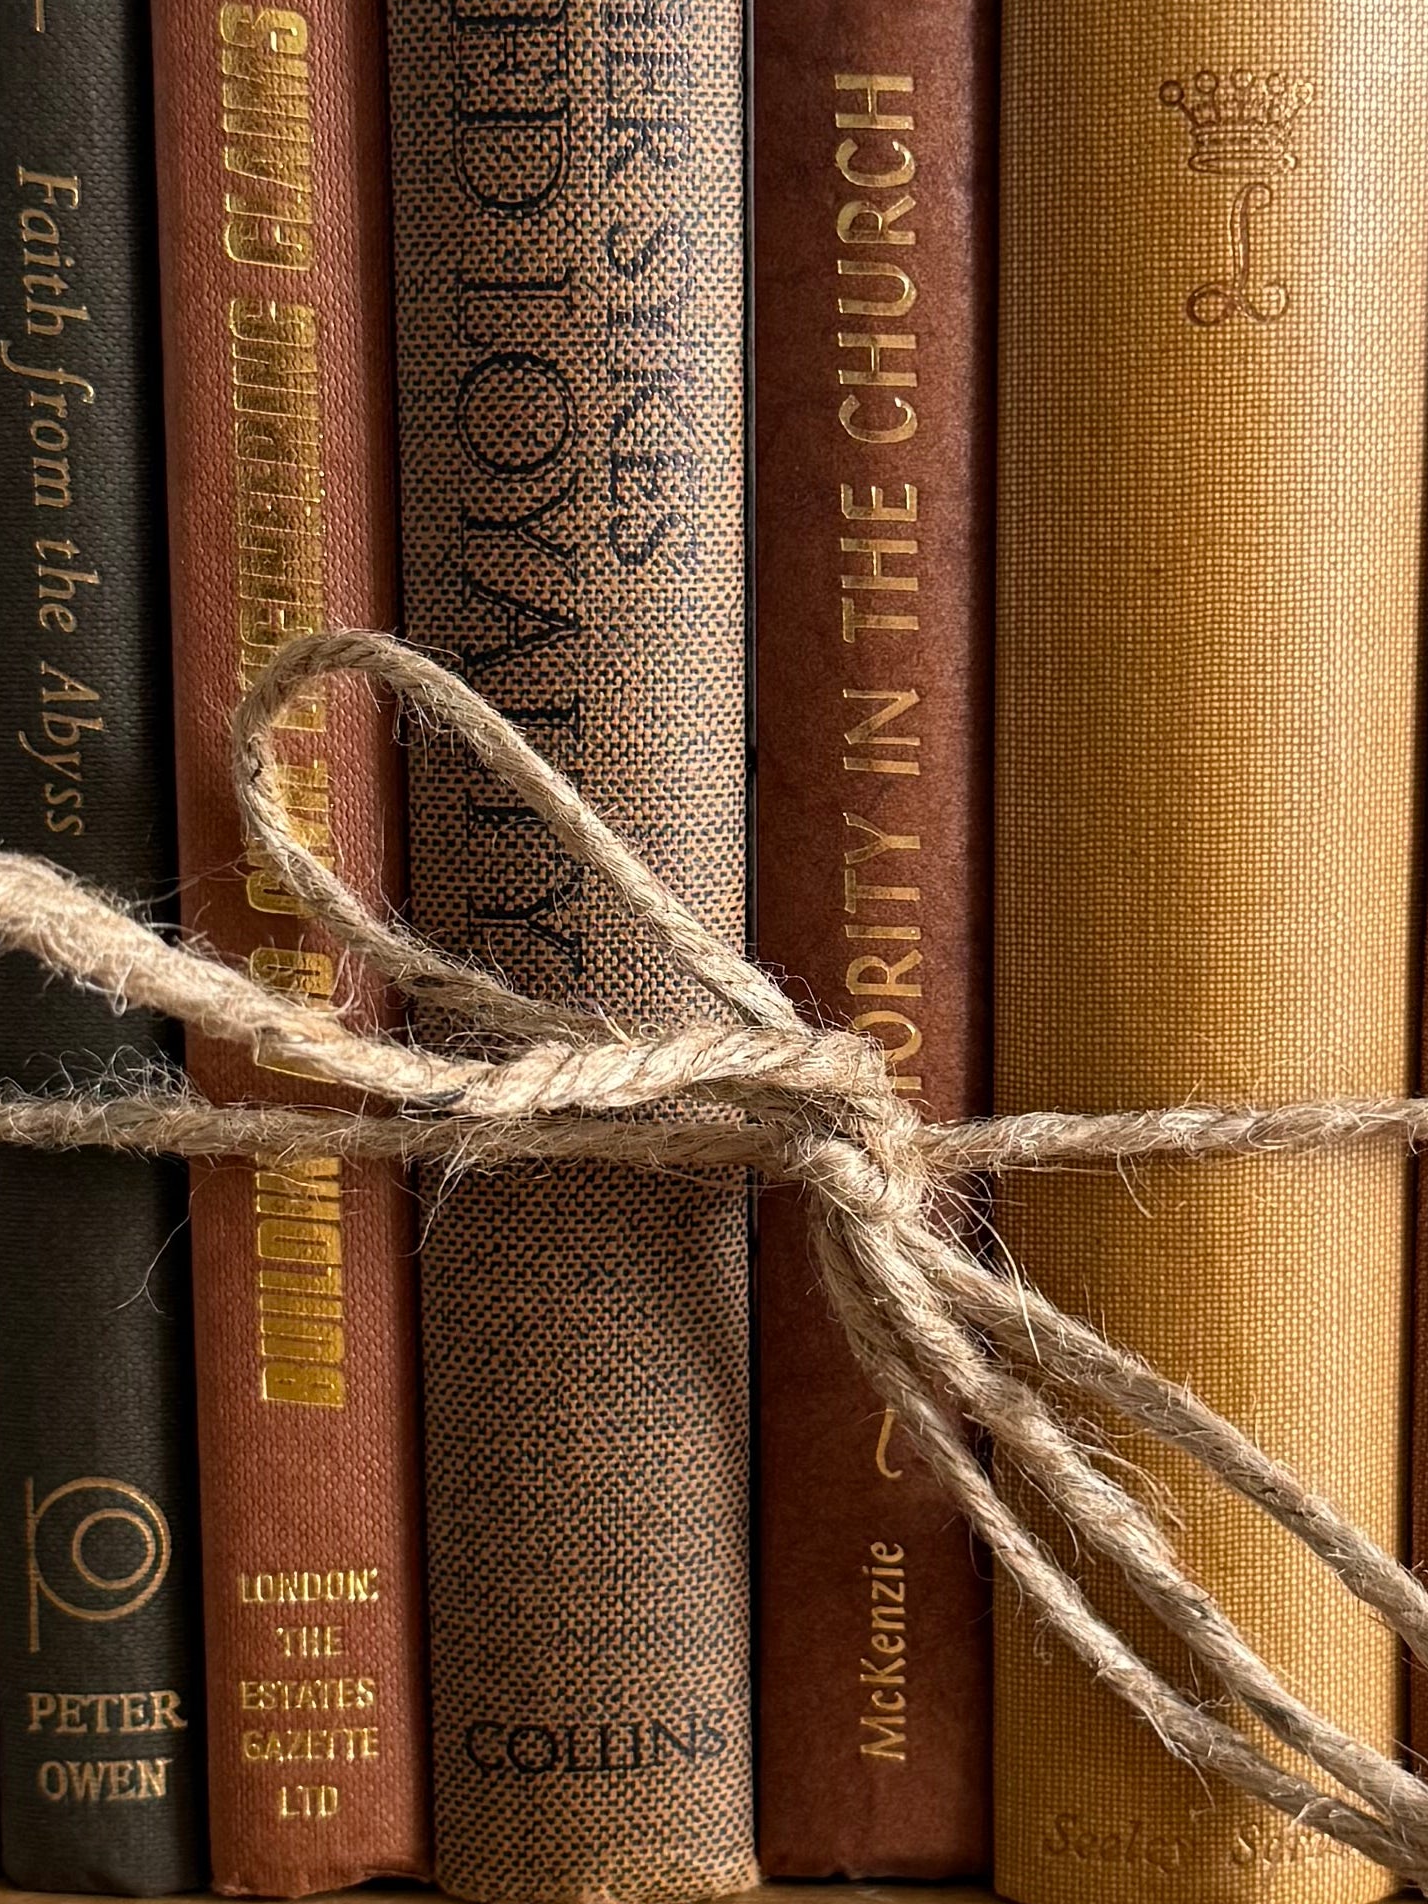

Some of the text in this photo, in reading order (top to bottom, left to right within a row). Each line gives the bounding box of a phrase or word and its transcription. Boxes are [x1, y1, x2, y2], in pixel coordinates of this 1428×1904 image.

[220, 0, 315, 272] CLAIMS
[605, 222, 698, 568] SYKES
[0, 164, 105, 838] Faith from the Abyss
[456, 273, 582, 974] LOYALTY
[834, 73, 924, 1093] ORITY IN THE CHURCH
[249, 946, 341, 1086] AD
[254, 1110, 347, 1410] BUILDIN
[27, 1688, 188, 1736] PETER
[239, 1678, 377, 1711] ESTATES
[276, 1626, 346, 1658] THE
[859, 1539, 908, 1763] McKenzie
[38, 1757, 173, 1803] OWEN
[241, 1727, 381, 1763] GAZETTE
[278, 1784, 341, 1822] LTD
[462, 1706, 729, 1776] COLLINS
